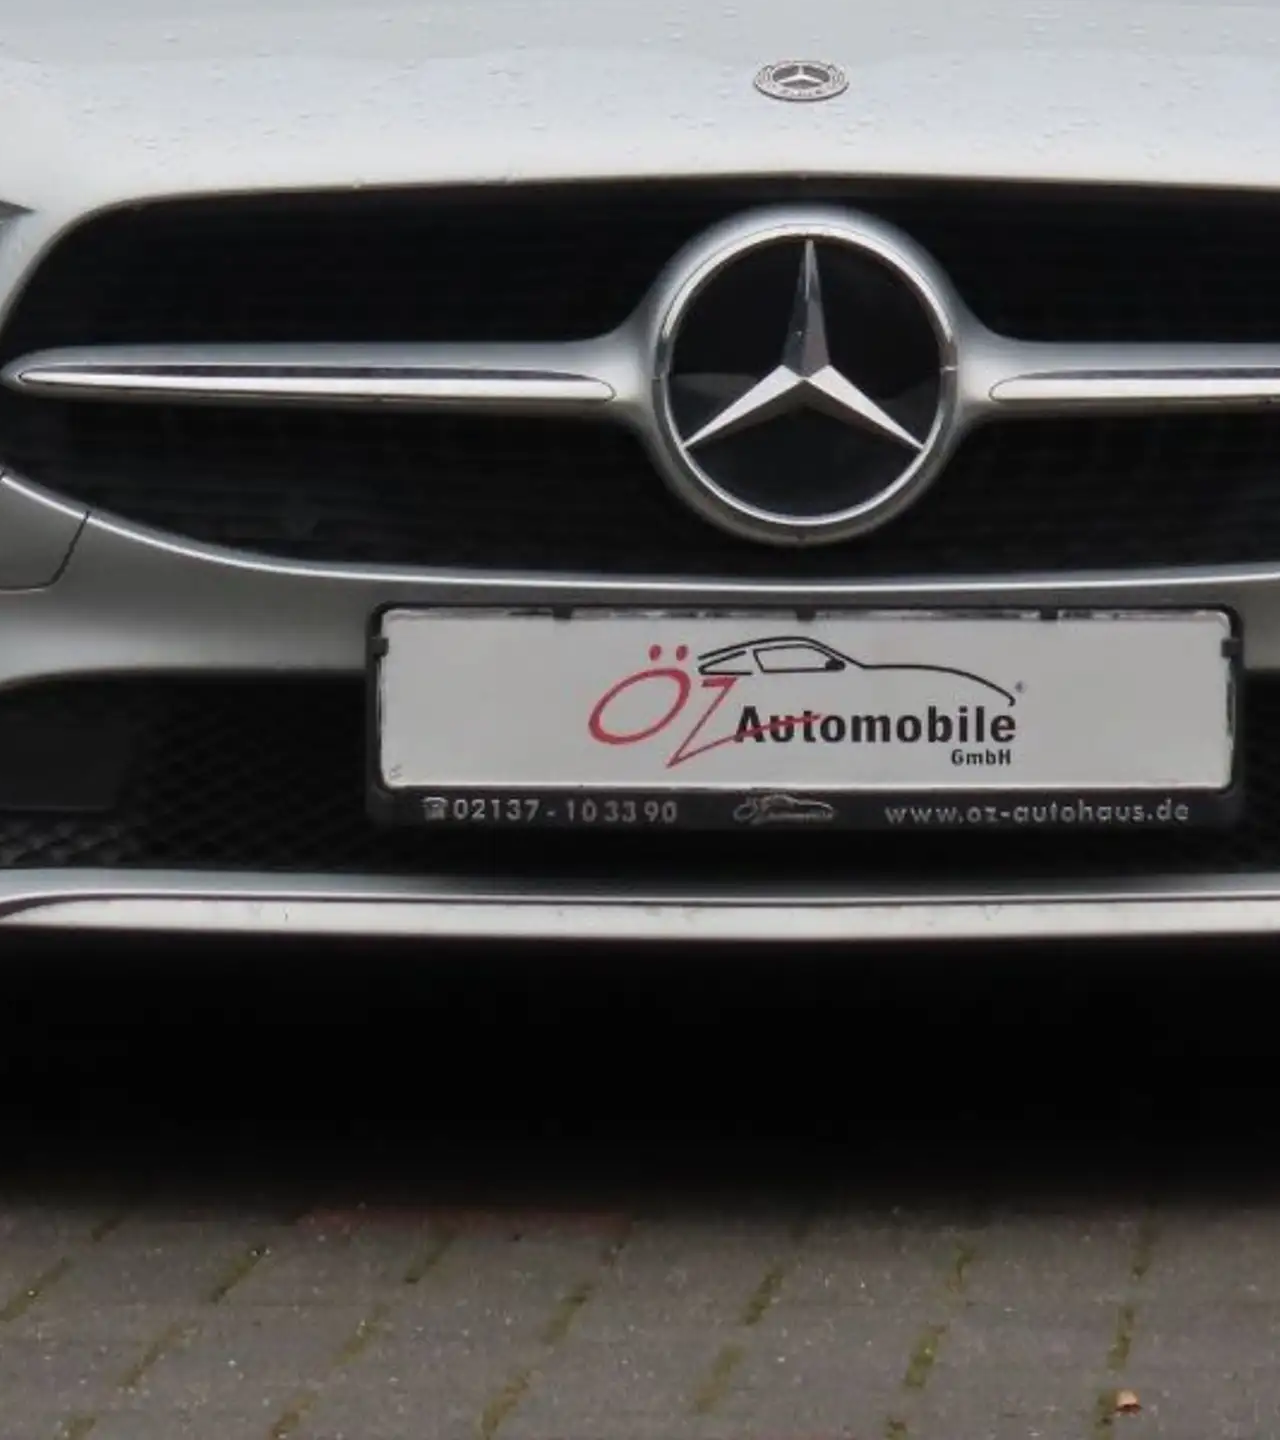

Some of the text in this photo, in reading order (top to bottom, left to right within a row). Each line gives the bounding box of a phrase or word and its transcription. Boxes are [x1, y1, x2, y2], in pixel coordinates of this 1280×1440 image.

[735, 705, 1017, 744] Automobile
[950, 748, 1012, 766] GmbH
[884, 797, 1190, 825] www.oz-autohaus.de
